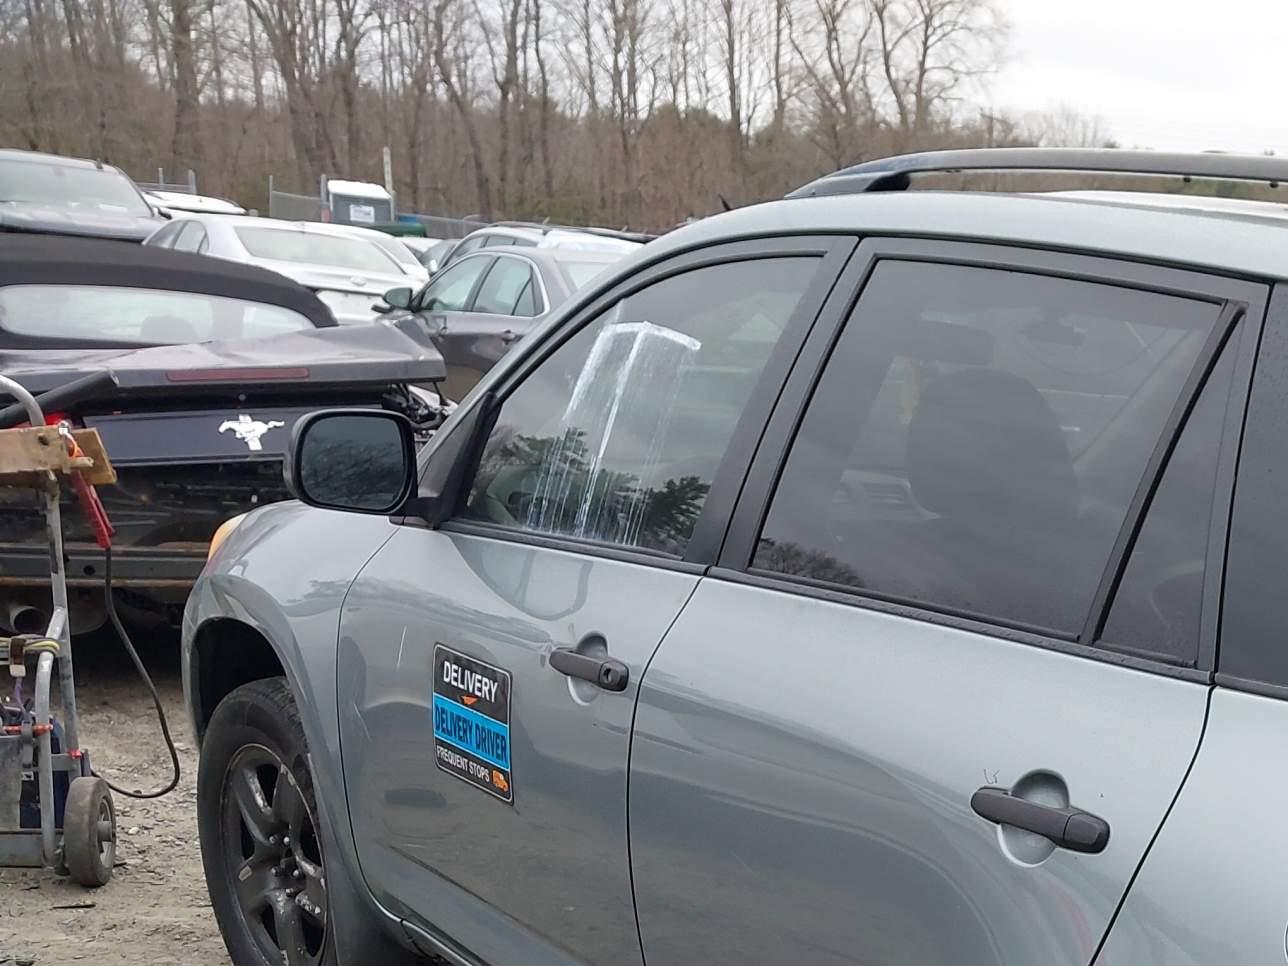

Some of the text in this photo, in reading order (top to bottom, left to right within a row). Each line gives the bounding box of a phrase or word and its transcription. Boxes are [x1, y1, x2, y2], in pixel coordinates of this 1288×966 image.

[444, 661, 498, 702] DELIVERY
[435, 706, 506, 763] DELIVERY DRIVER
[437, 746, 490, 782] FREQUENT STOPS
